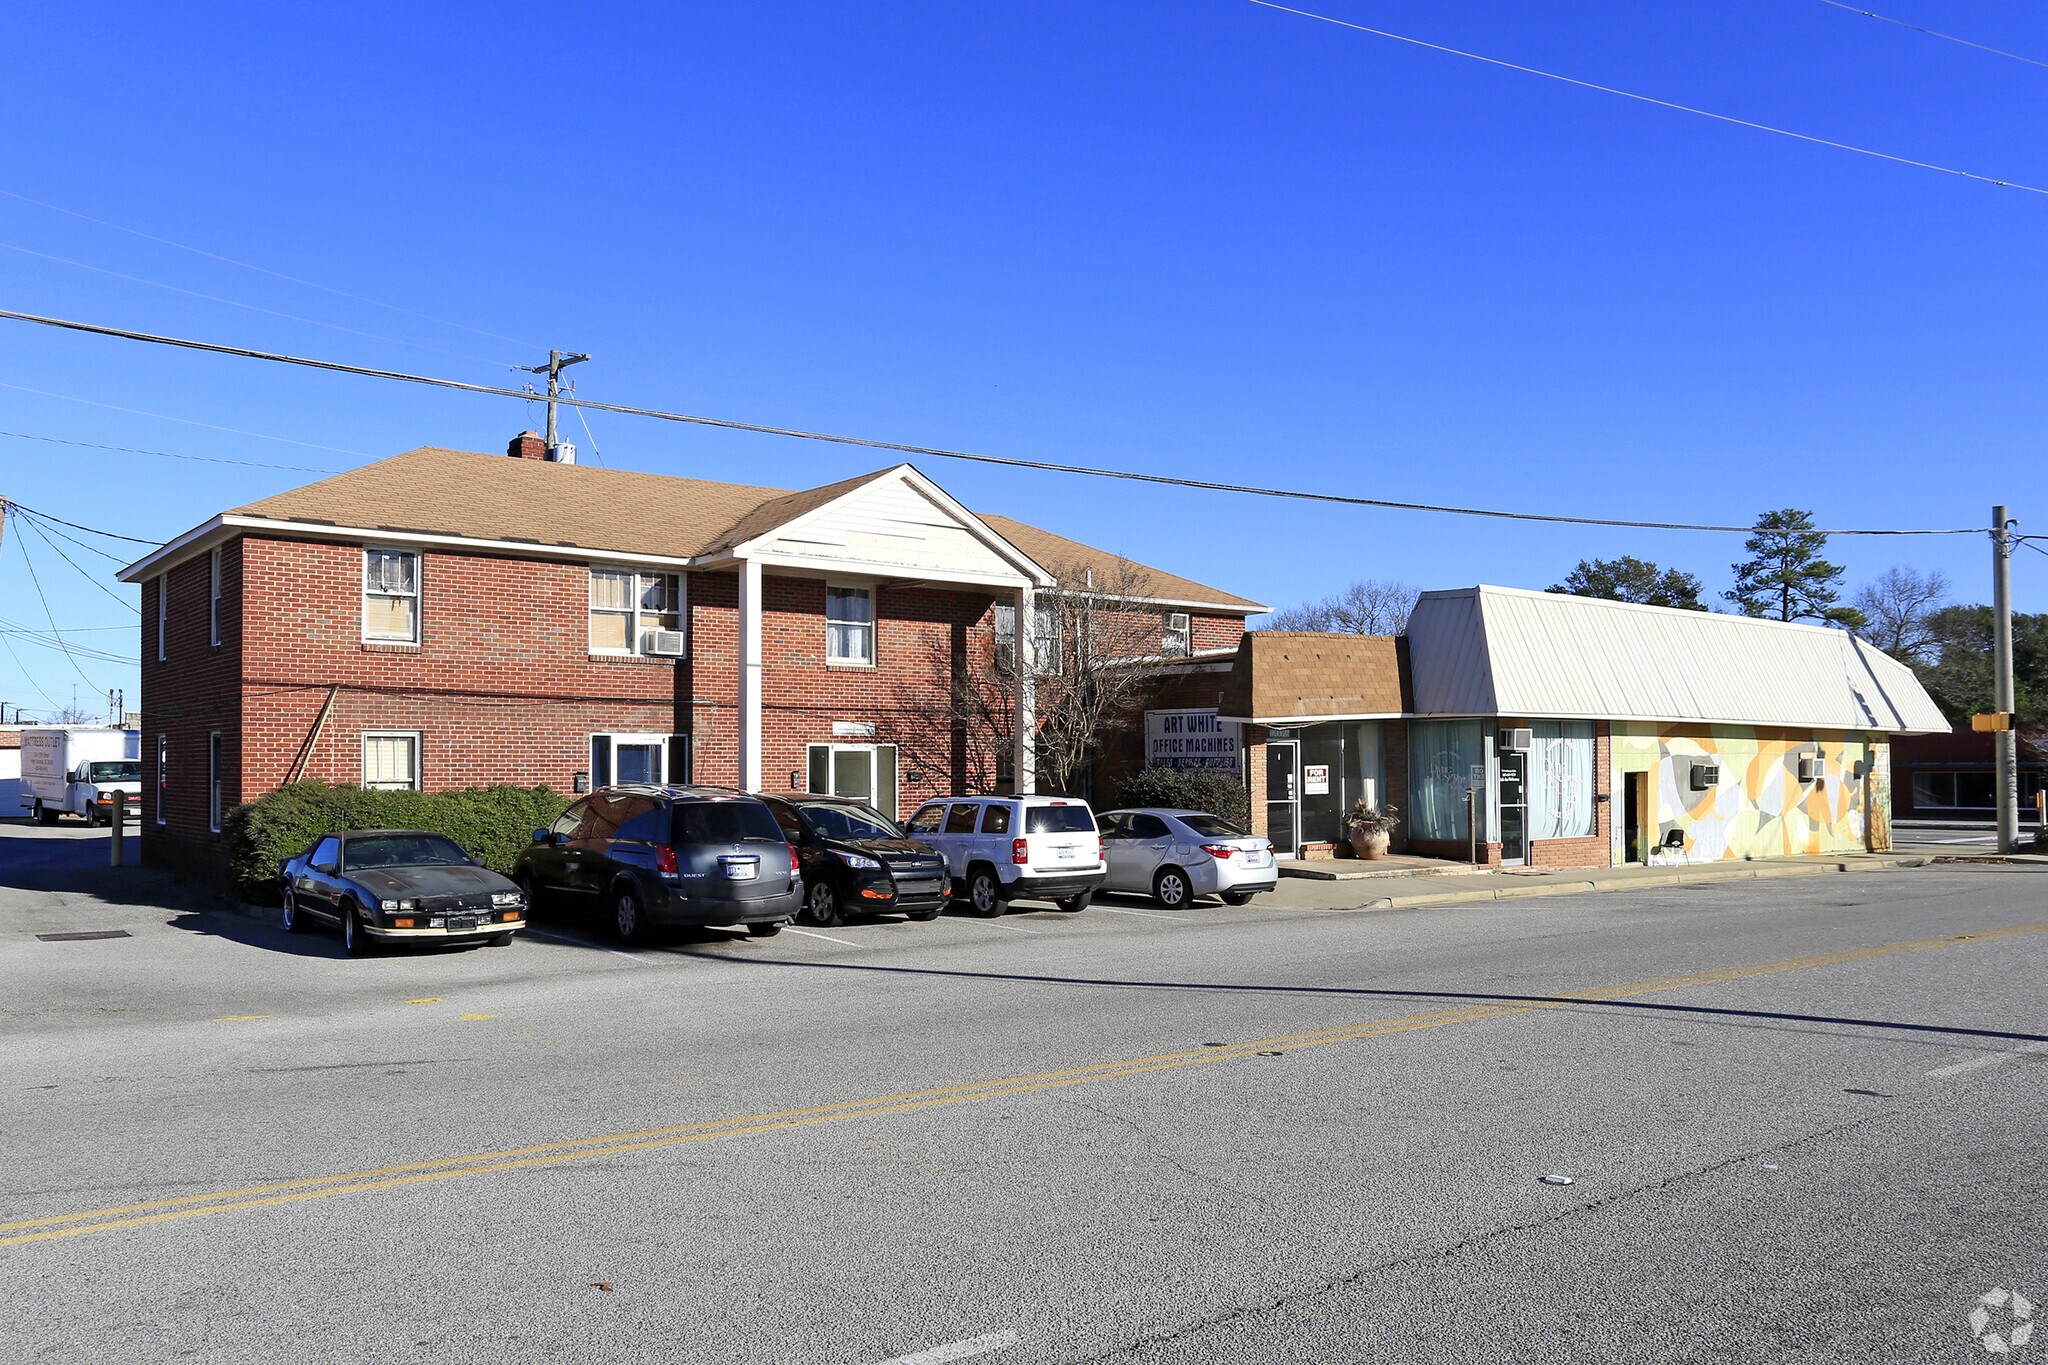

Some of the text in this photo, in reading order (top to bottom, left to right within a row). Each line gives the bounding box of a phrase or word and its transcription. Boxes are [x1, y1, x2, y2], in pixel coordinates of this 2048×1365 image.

[1164, 715, 1222, 733] ART WHITE
[1153, 737, 1234, 753] OFFICE MACHINES
[1309, 769, 1324, 777] FOR
